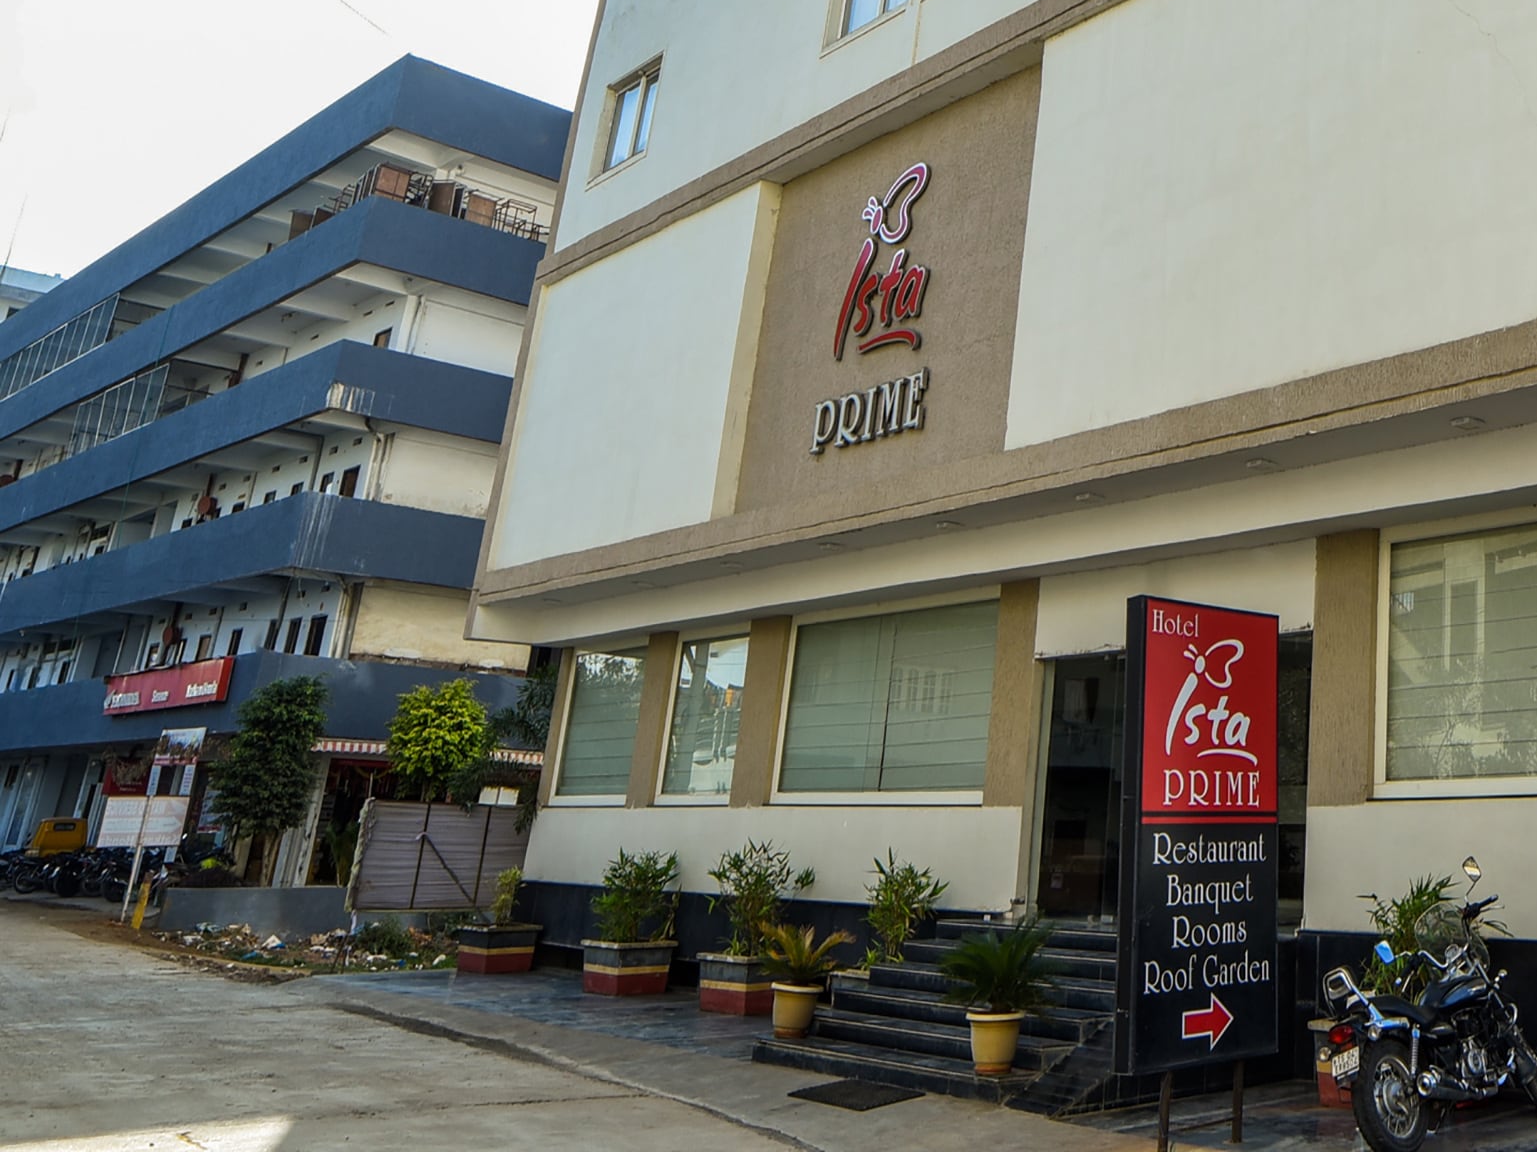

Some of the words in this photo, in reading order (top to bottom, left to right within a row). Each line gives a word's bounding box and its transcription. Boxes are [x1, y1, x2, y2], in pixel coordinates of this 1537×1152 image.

[834, 237, 930, 361] Ista
[809, 367, 930, 455] PRIME
[1152, 609, 1199, 638] Hotel
[1165, 672, 1251, 756] Ista
[1162, 768, 1261, 808] PRIME
[1152, 832, 1267, 865] Restaurant
[1165, 873, 1254, 915] Banquet
[1171, 915, 1247, 948] Rooms
[1144, 954, 1195, 995] Roof
[1202, 955, 1270, 986] Garden
